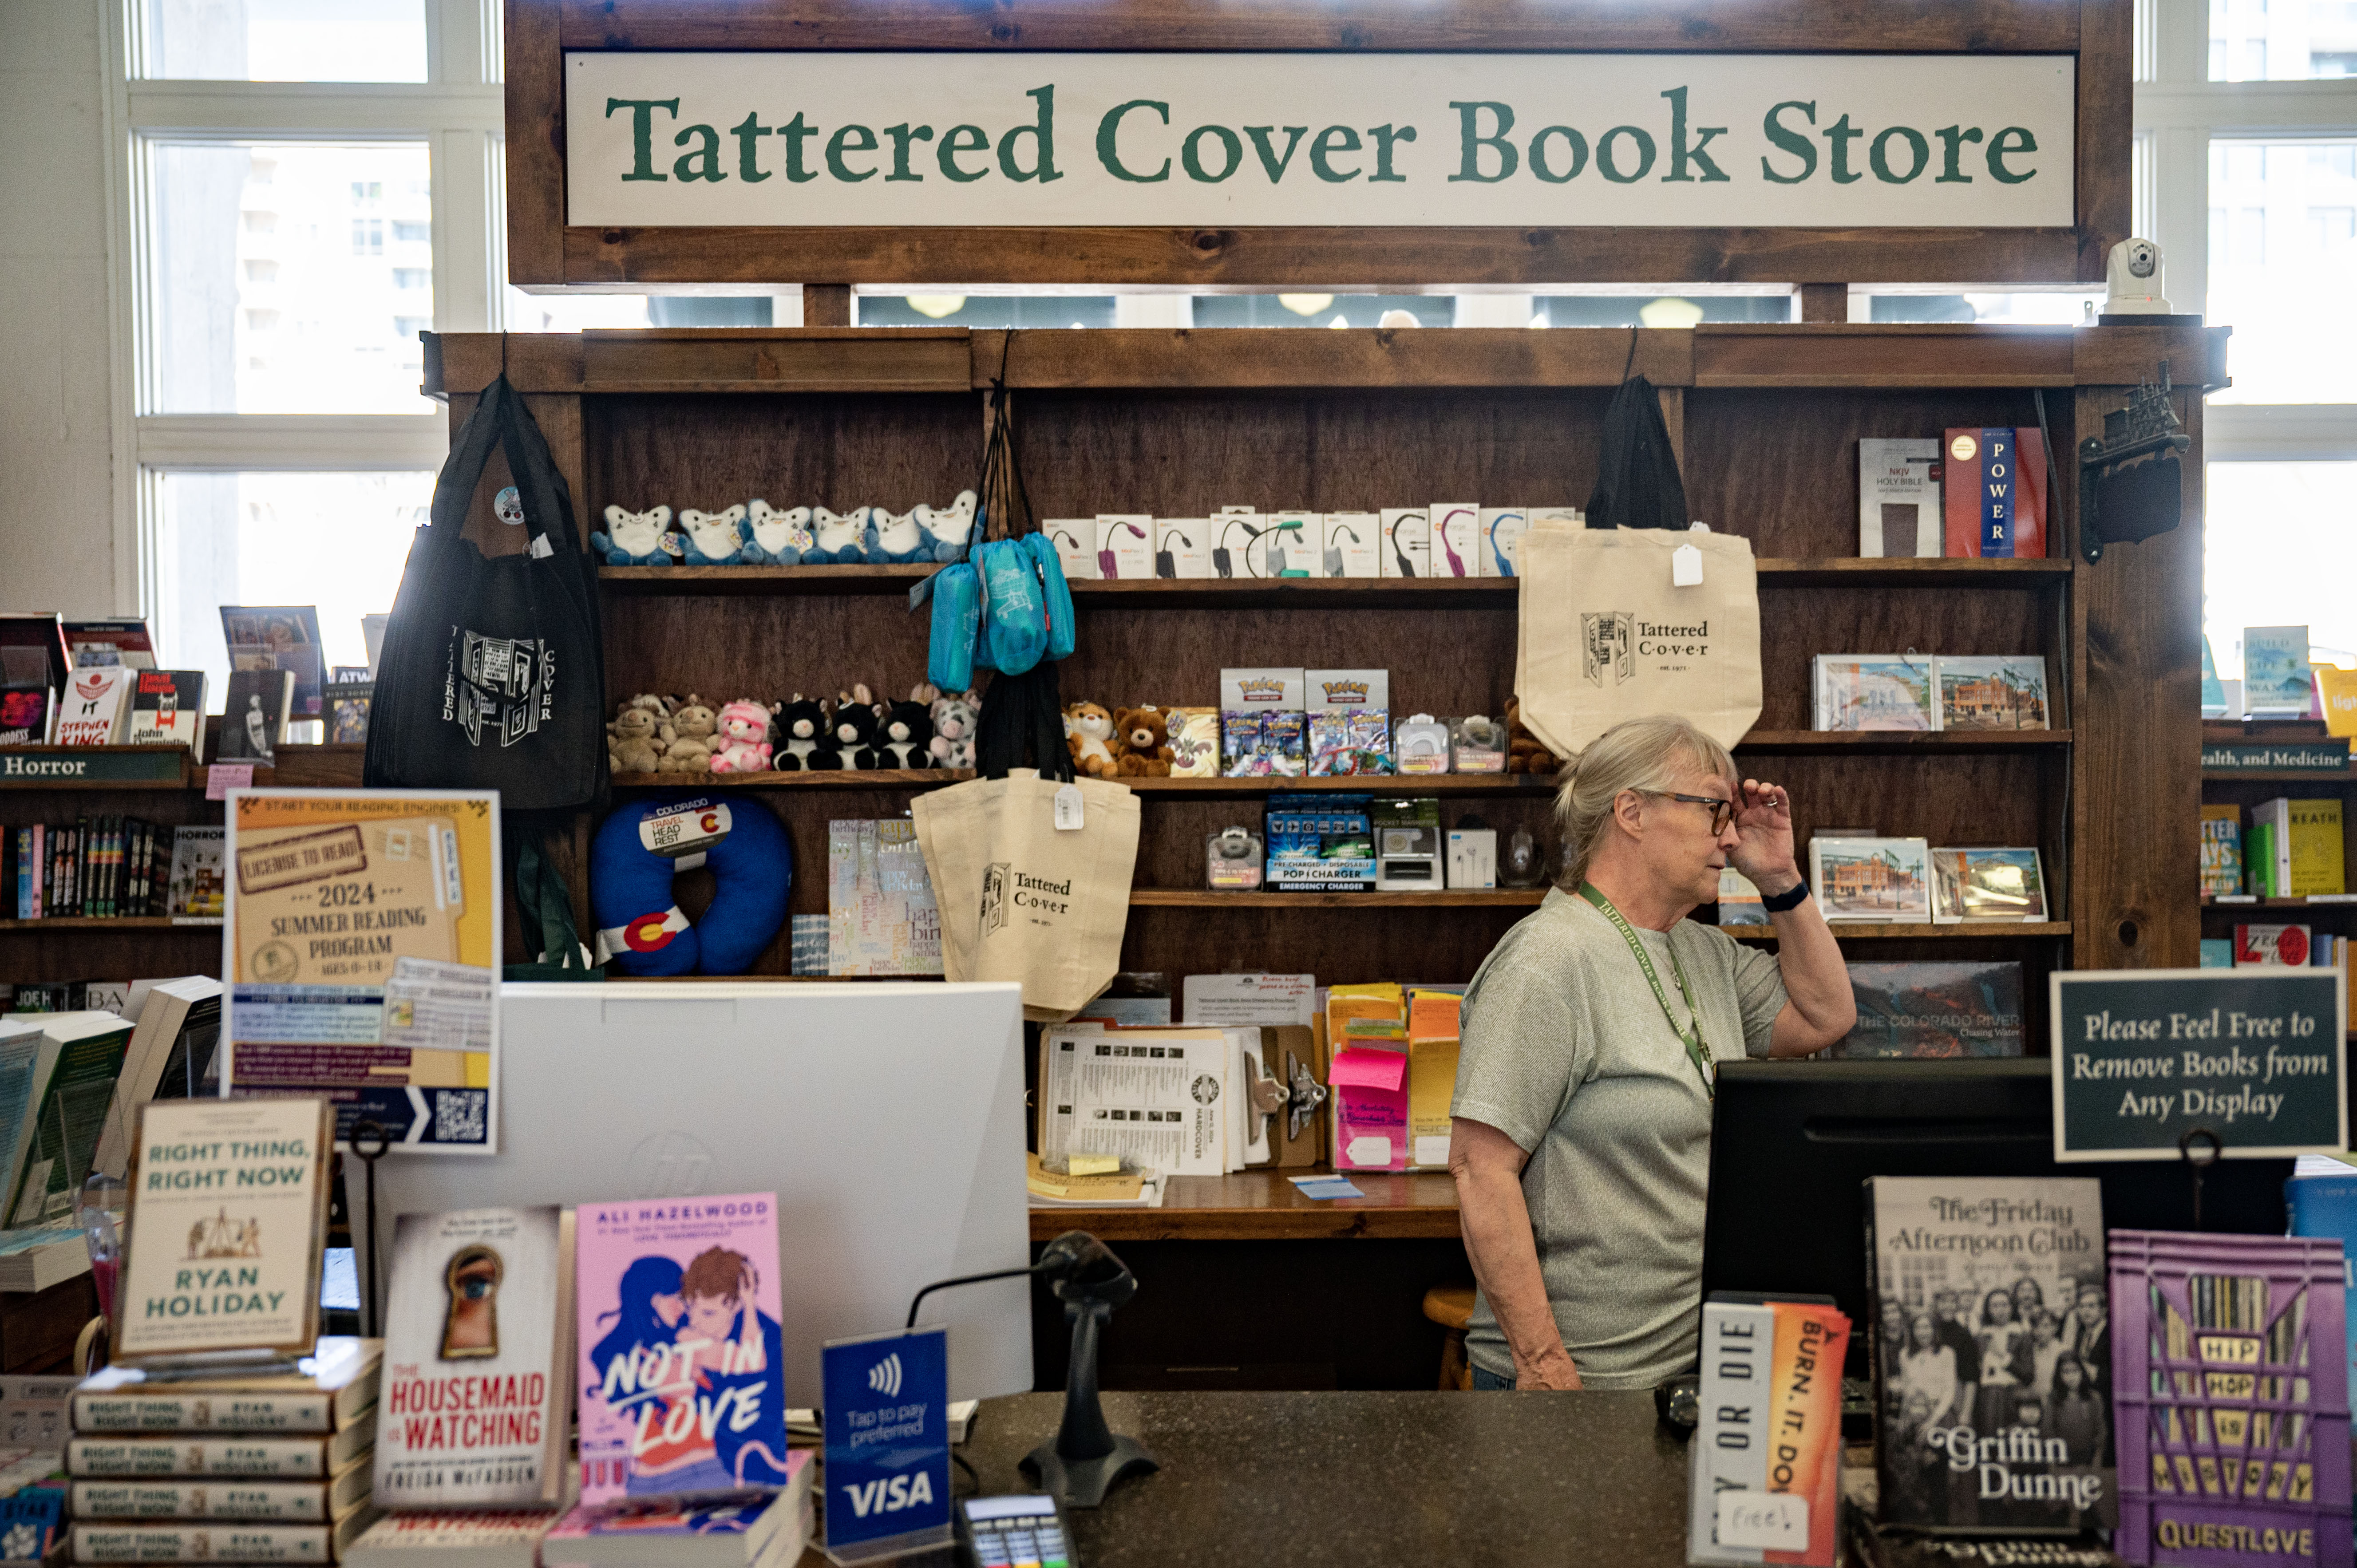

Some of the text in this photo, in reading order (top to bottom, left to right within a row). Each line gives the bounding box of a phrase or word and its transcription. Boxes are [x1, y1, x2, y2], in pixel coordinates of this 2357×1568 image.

[605, 84, 2038, 184] Tattered Cover Book Store
[1989, 443, 2007, 539] POWER
[1638, 620, 1708, 636] Tattered
[82, 701, 99, 715] IT
[0, 728, 28, 746] ODDESS
[60, 719, 110, 733] STEPHEN
[61, 732, 105, 745] KING
[134, 728, 163, 738] John
[4, 756, 86, 775] Horror
[2242, 750, 2342, 766] and Medicine
[656, 798, 708, 816] COLORADO
[650, 815, 684, 829] TRAVEL
[653, 825, 680, 837] HEAD
[655, 833, 680, 846] REST
[244, 841, 357, 879] LICENSE TO READ
[318, 882, 375, 907] 2024
[1015, 872, 1071, 895] Tattered
[271, 907, 427, 937] SUMMER READING
[310, 936, 392, 959] PROGRAM
[16, 990, 40, 1007] JOE
[1859, 1014, 2020, 1028] THE COLORADO RIVER
[1960, 1028, 2020, 1038] Chasing Water
[2085, 1008, 2314, 1041] Please Feel Free to
[2072, 1045, 2328, 1085] Remove Books from
[2118, 1084, 2284, 1123] Any Display
[148, 1139, 309, 1163] RIGHT THING,
[147, 1166, 305, 1191] RIGHT NOW
[597, 1201, 768, 1224] ALI HAZELWOOD
[1929, 1196, 2073, 1228] The Friday
[1889, 1227, 2023, 1257] Afternoon
[2027, 1227, 2089, 1256] Club
[175, 1267, 259, 1290] RYAN
[146, 1292, 286, 1318] HOLIDAY
[604, 1331, 765, 1399] NOT IN
[1790, 1320, 1821, 1401] BURN.
[389, 1371, 545, 1415] HOUSEMAID
[1716, 1321, 1755, 1450] OR DIE
[634, 1381, 768, 1457] LOVE
[846, 1402, 927, 1432] Tap to pay
[1782, 1410, 1805, 1436] IT.
[404, 1411, 540, 1451] WATCHING
[850, 1416, 924, 1449] preferred
[843, 1471, 933, 1518] VISA
[2157, 1520, 2314, 1556] QUESTLOVE
